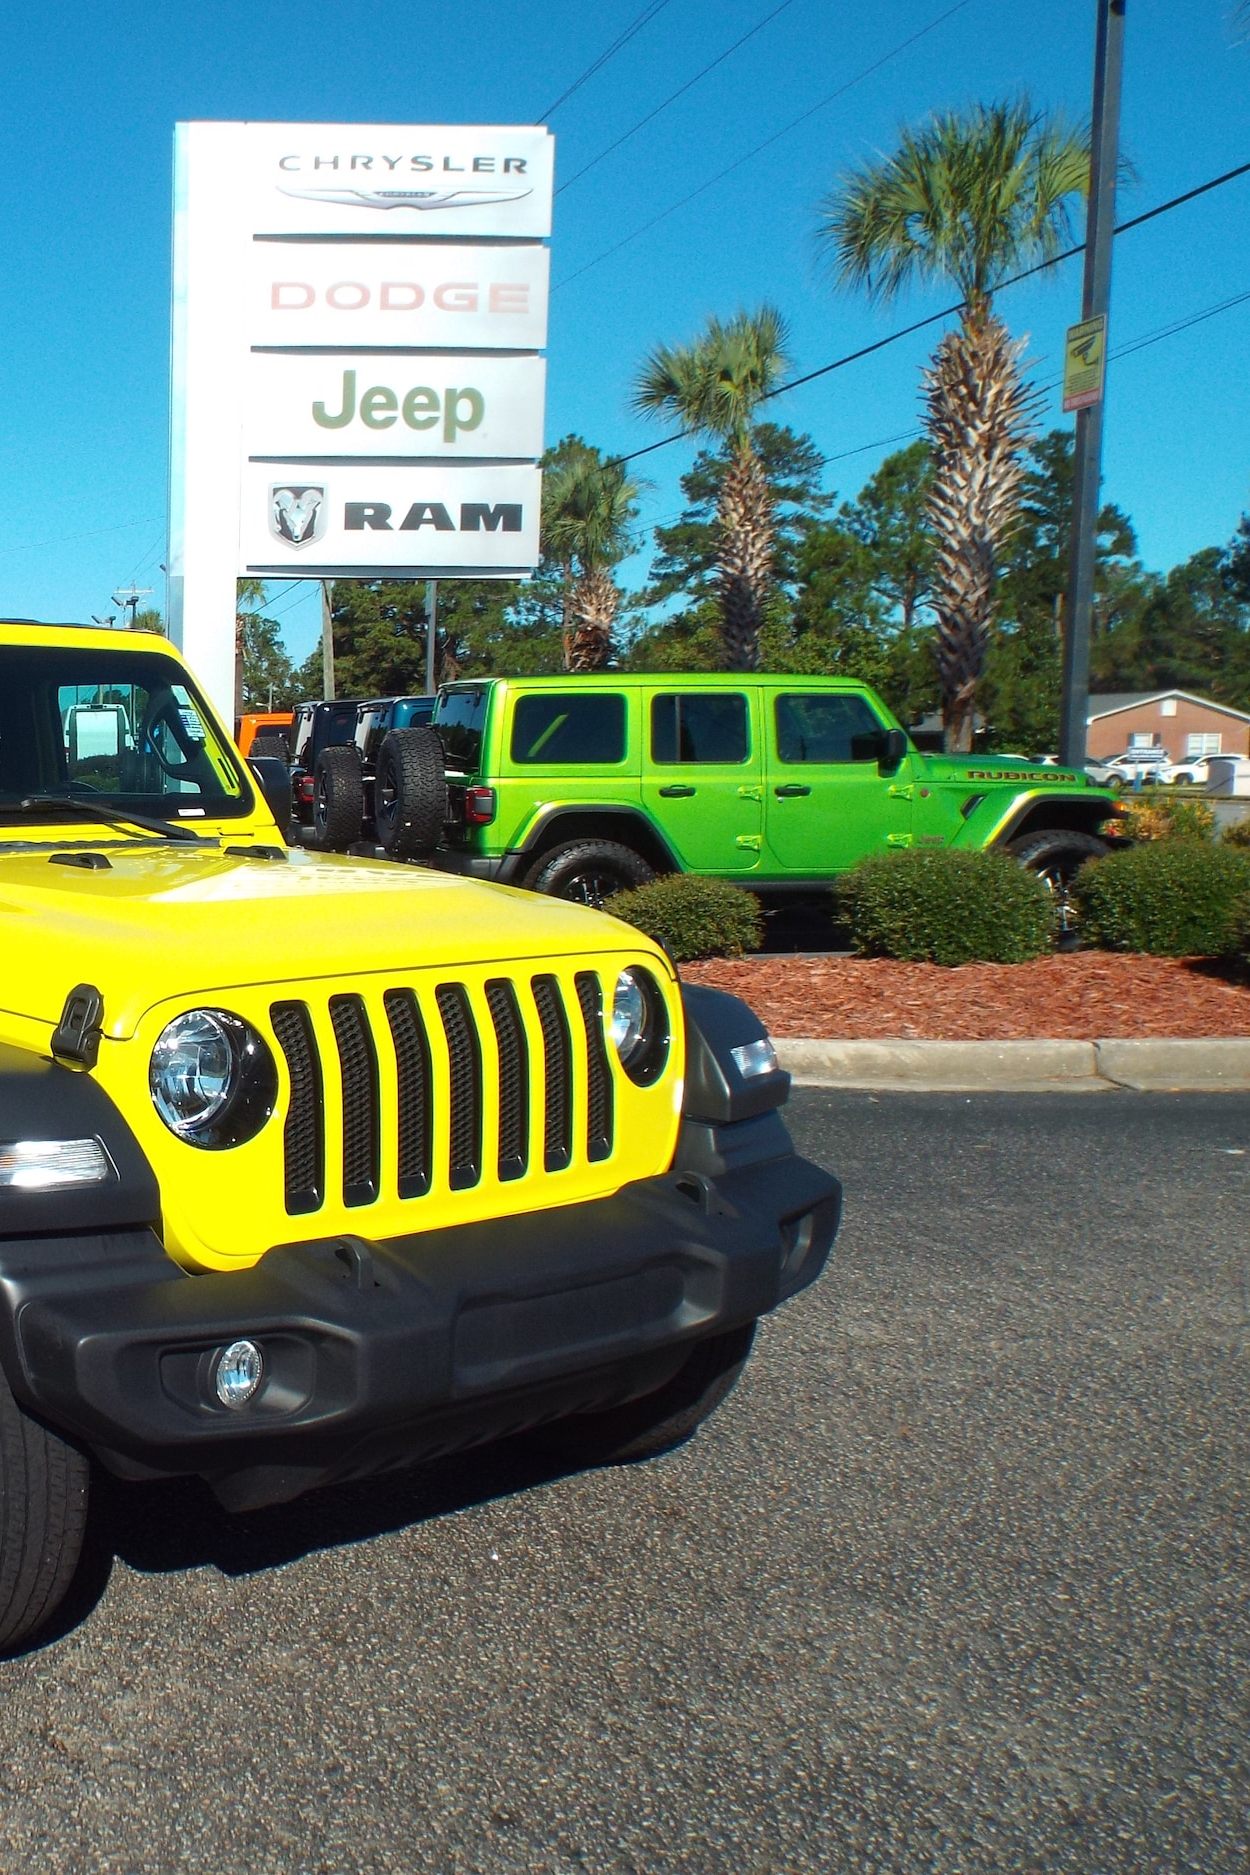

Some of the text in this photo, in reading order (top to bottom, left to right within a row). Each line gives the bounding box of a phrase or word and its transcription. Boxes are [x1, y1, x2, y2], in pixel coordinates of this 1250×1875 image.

[278, 155, 528, 175] CHRYSLER
[270, 281, 530, 314] DODGE
[311, 369, 485, 443] Jeep
[344, 501, 523, 532] RAM
[966, 770, 1076, 783] RUBICON
